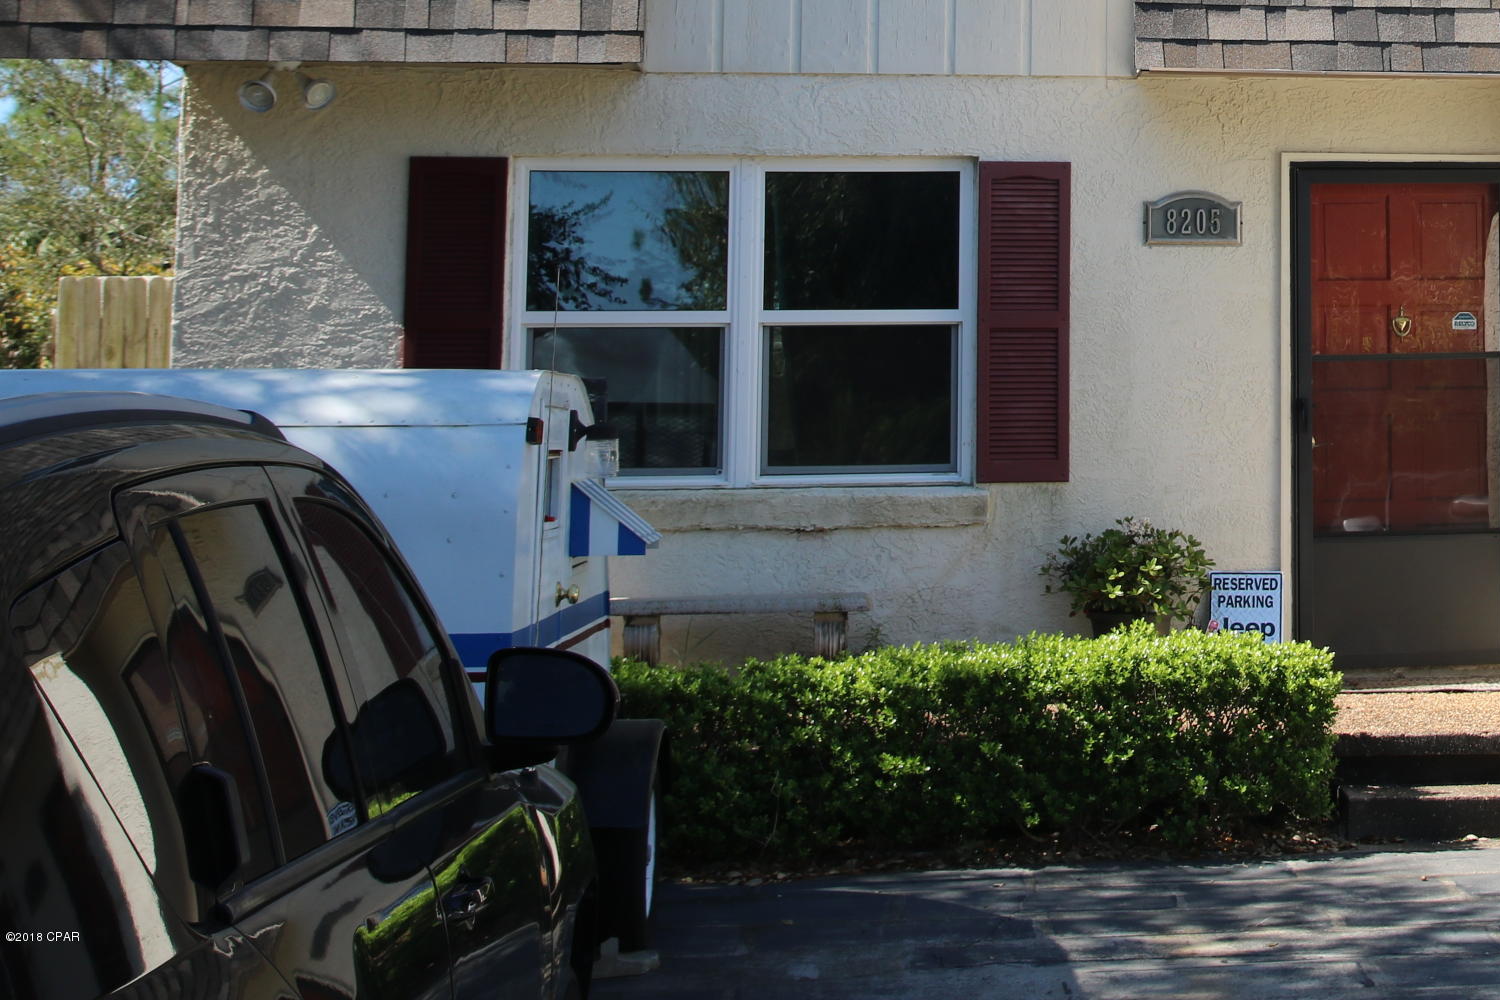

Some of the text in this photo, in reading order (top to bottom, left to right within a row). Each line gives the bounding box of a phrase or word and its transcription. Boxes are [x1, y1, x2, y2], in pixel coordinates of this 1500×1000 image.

[1166, 208, 1221, 235] 8205
[1213, 577, 1278, 591] RESERVED
[1217, 595, 1274, 609] PARKING
